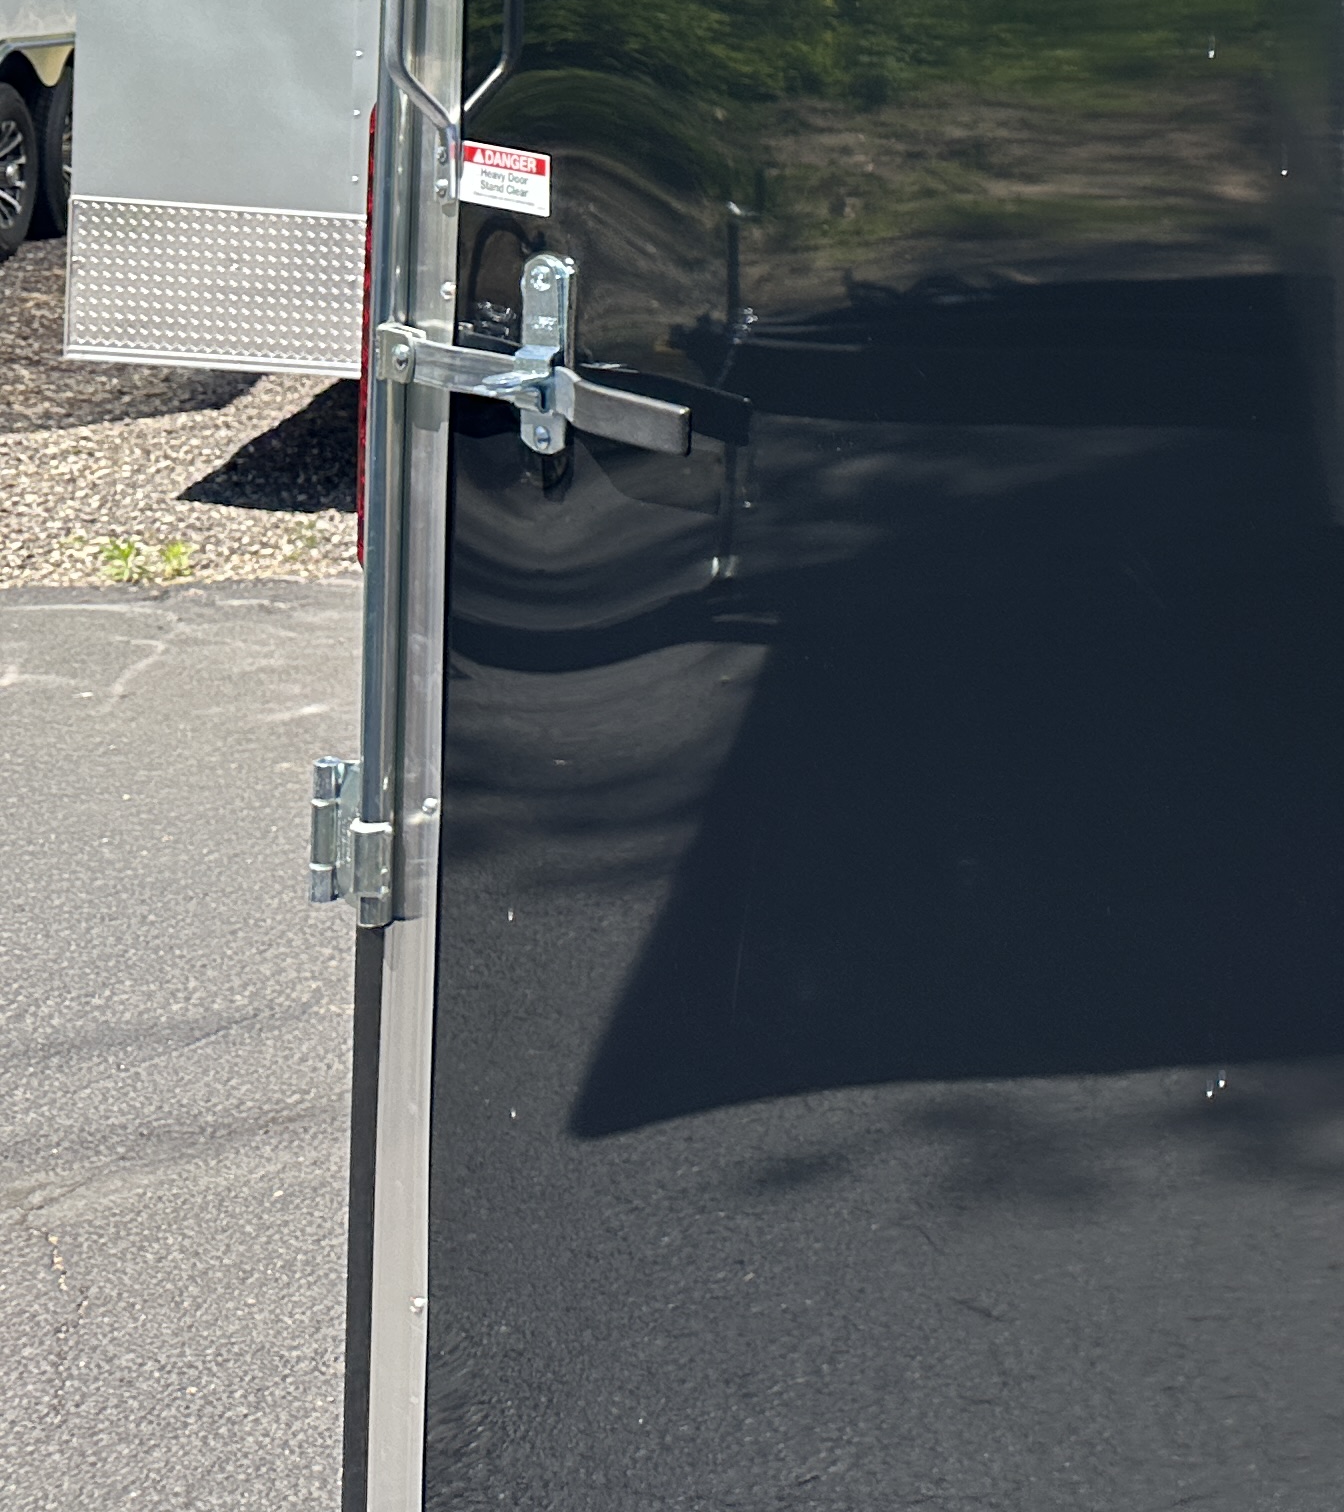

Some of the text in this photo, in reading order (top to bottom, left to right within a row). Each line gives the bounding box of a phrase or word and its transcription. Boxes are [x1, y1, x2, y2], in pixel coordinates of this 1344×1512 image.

[484, 149, 537, 173] DANGER
[480, 168, 528, 185] Heavy Door
[480, 179, 529, 197] Stand Clear
